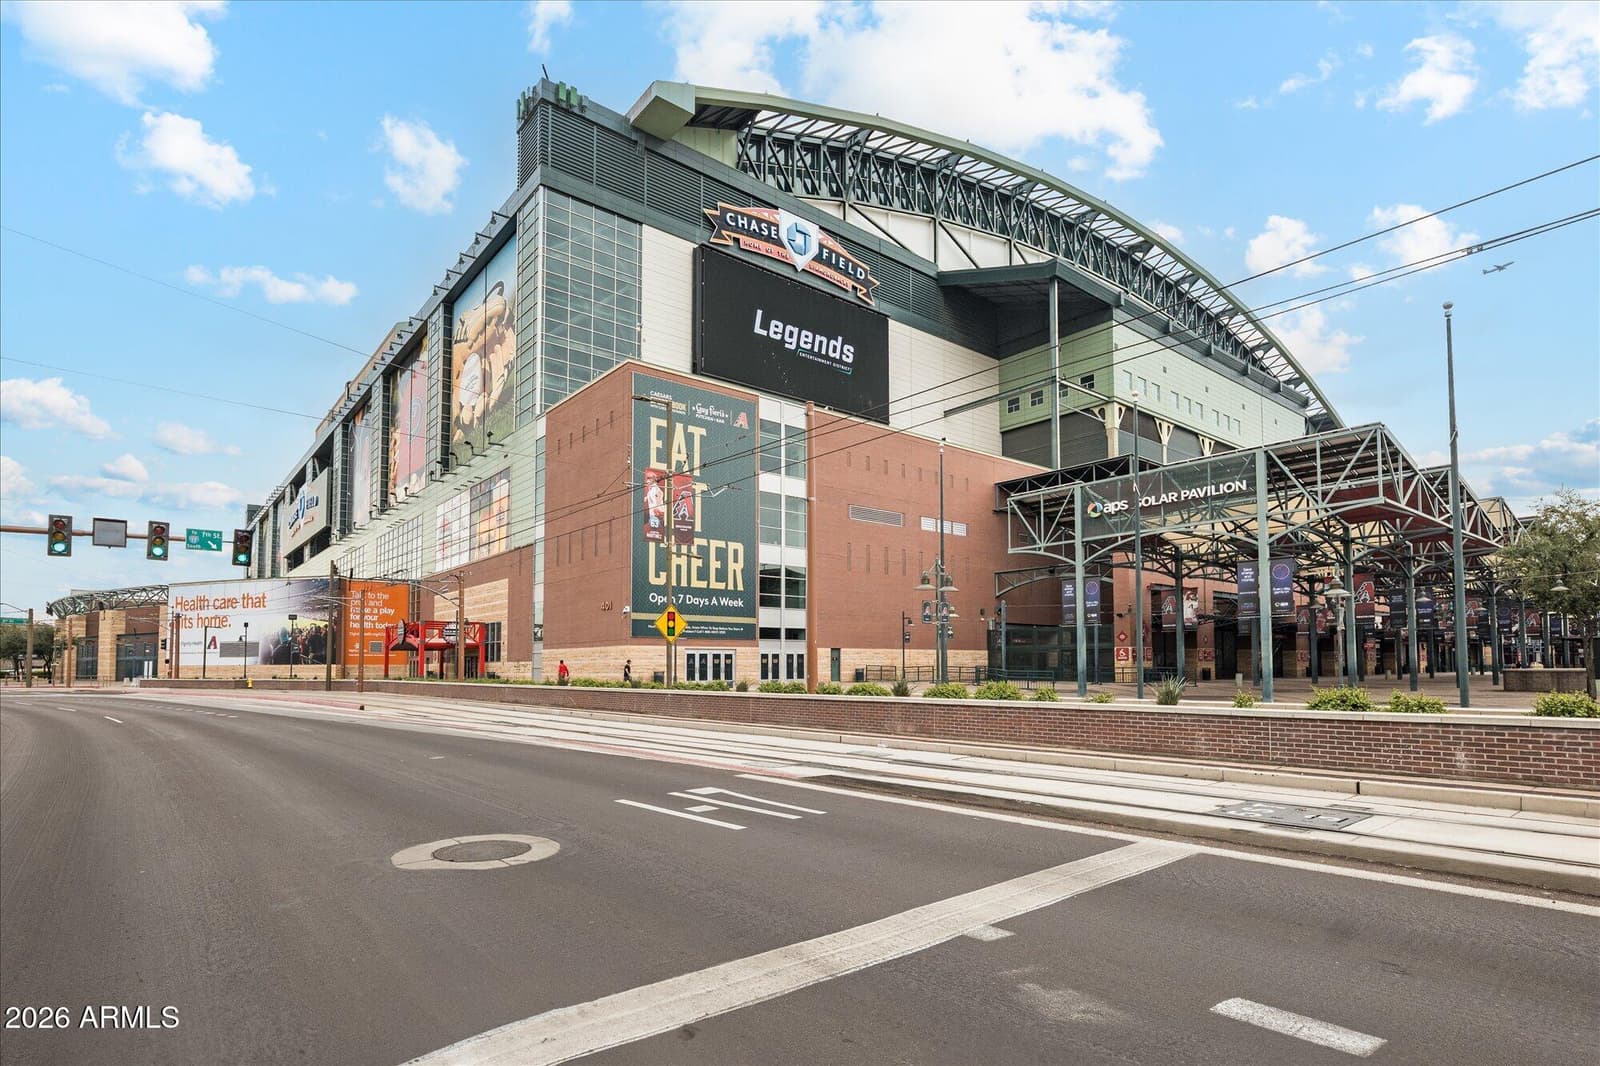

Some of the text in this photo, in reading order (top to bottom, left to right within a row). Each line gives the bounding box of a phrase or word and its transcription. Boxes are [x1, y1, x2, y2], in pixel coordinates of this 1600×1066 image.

[725, 212, 865, 281] CHASE FIELD
[753, 308, 855, 364] Legends
[649, 416, 707, 477] EAT
[1103, 499, 1129, 514] aps
[1180, 479, 1247, 501] PAVILION
[648, 537, 744, 591] CHEER
[175, 592, 267, 611] Health care that
[377, 592, 390, 600] the
[677, 593, 684, 604] 7
[686, 594, 709, 608] Days
[710, 596, 718, 606] A
[719, 596, 744, 608] Week
[196, 613, 232, 628] home.
[379, 607, 395, 616] play
[349, 621, 374, 629] helth
